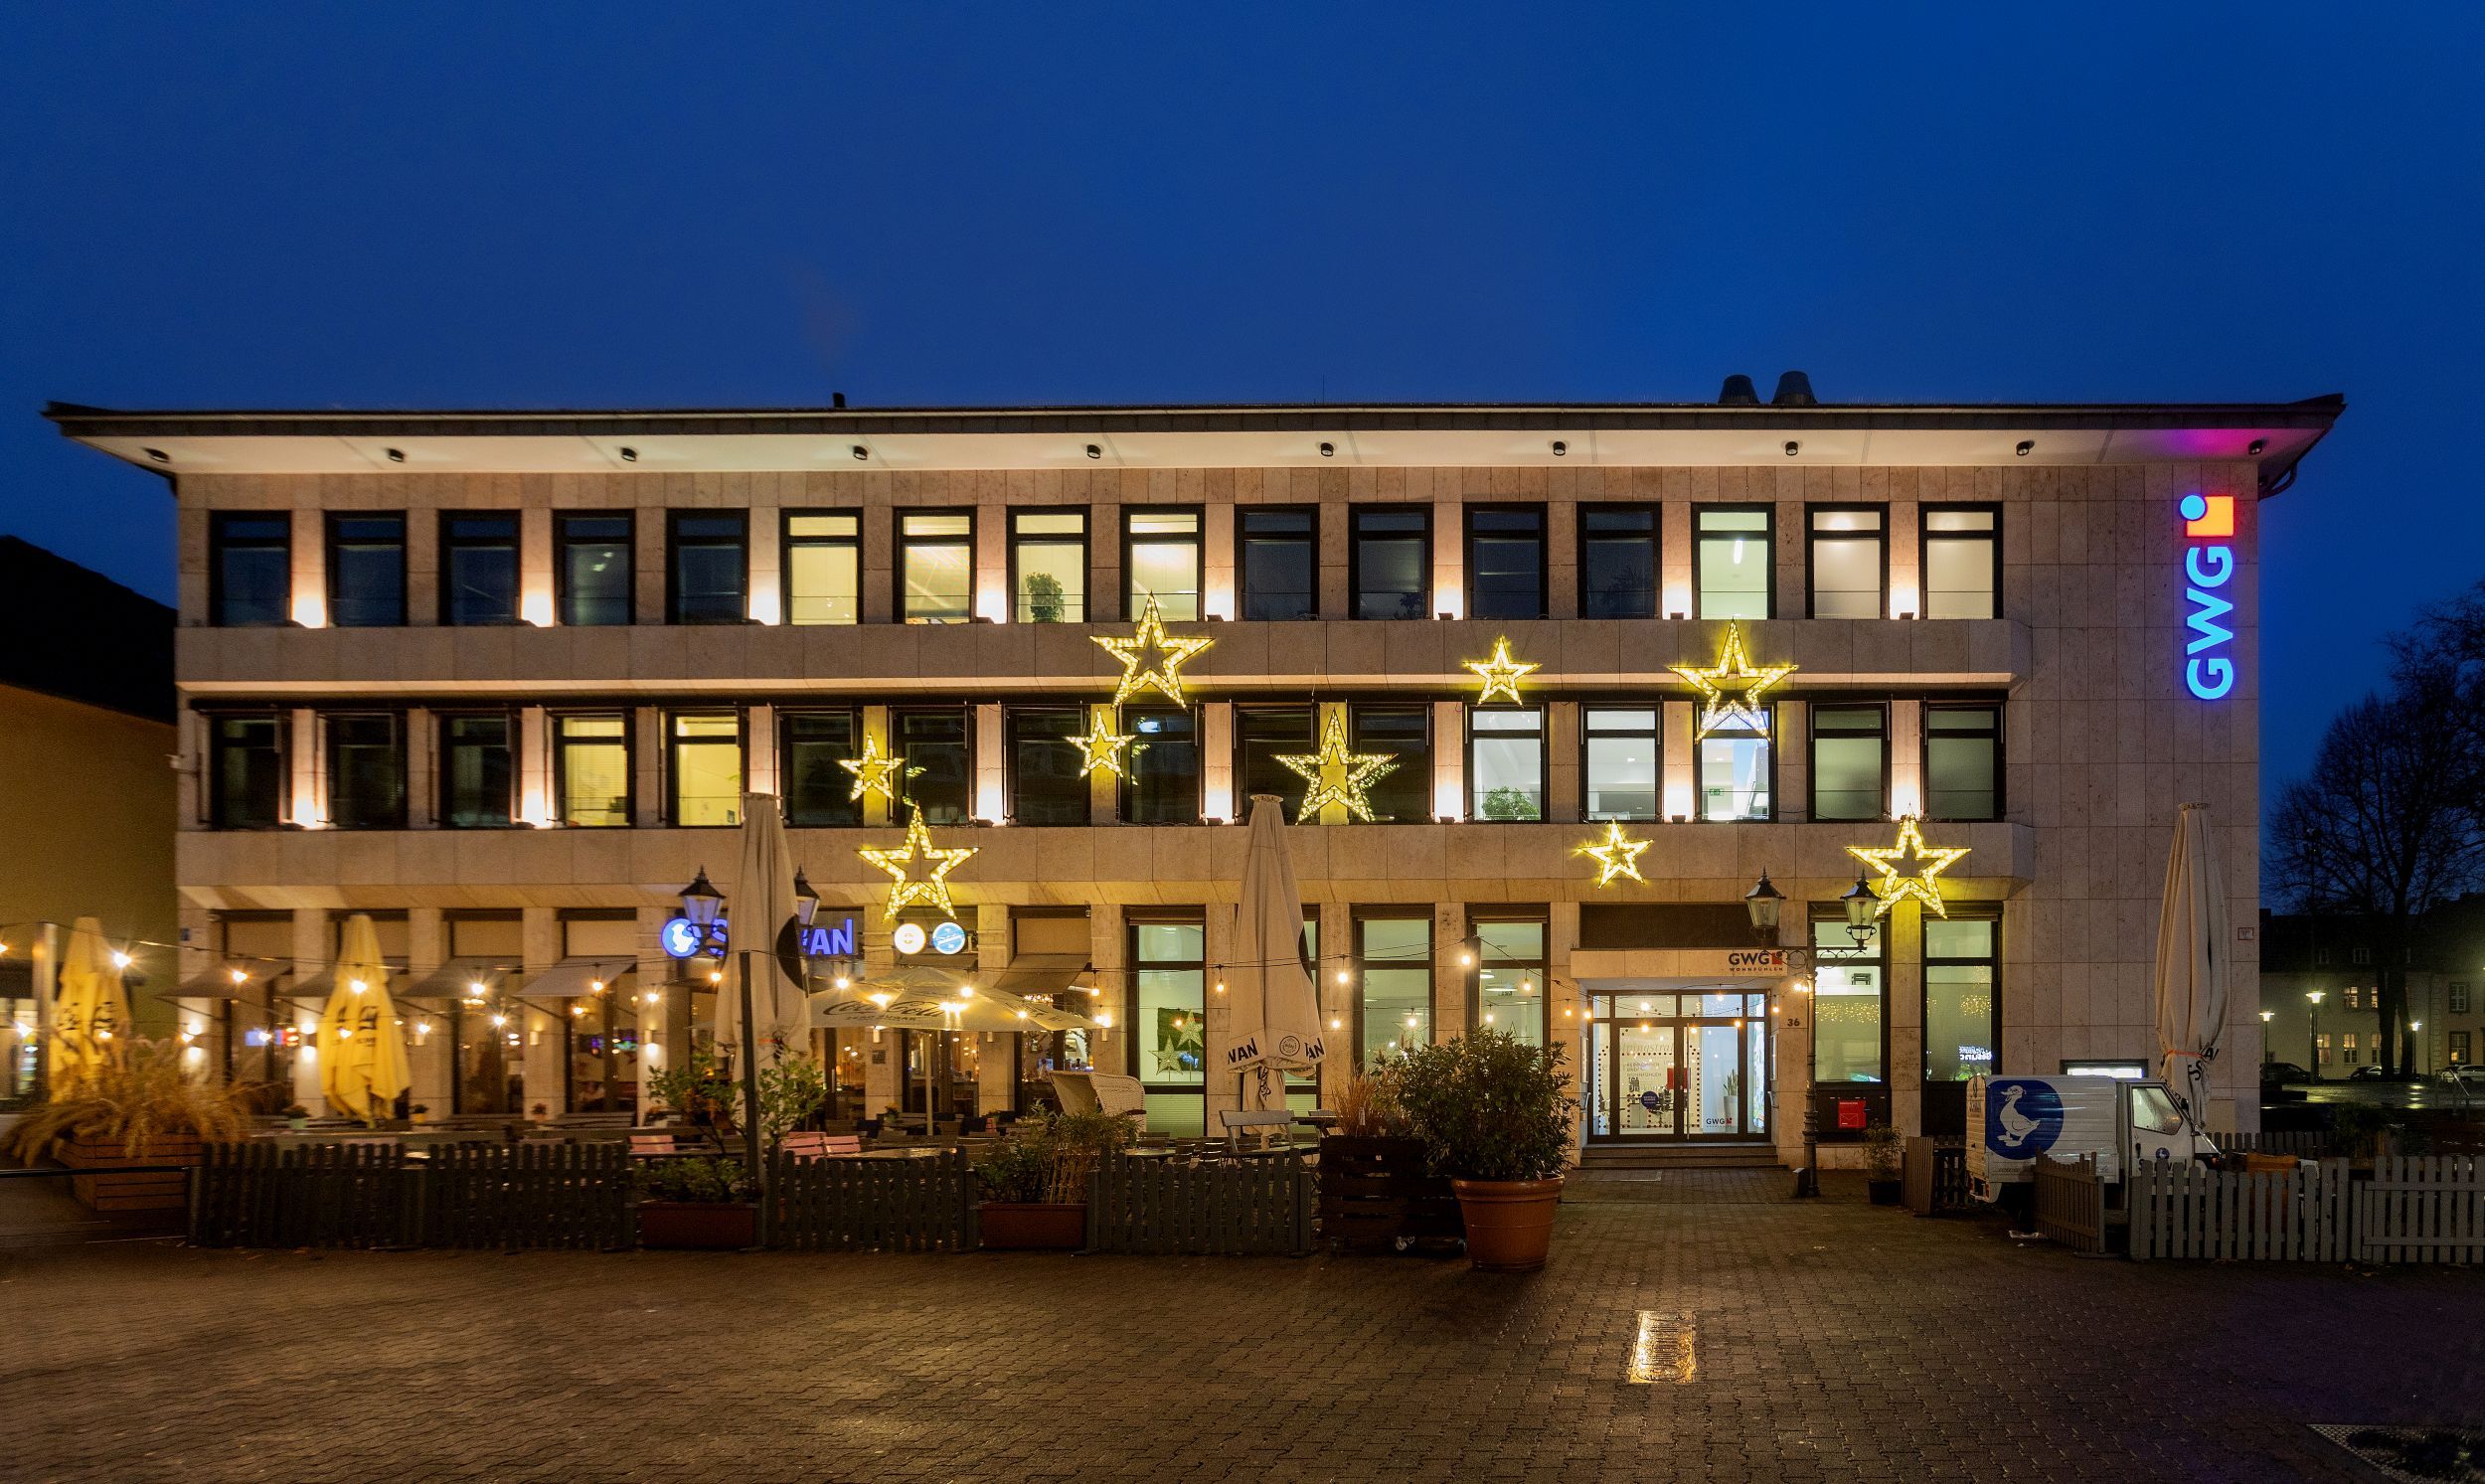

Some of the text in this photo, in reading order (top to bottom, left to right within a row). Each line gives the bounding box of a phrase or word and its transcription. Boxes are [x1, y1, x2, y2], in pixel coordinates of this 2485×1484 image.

[2186, 546, 2235, 700] GWG
[1728, 952, 1769, 965] GWG
[1786, 1018, 1800, 1027] 36
